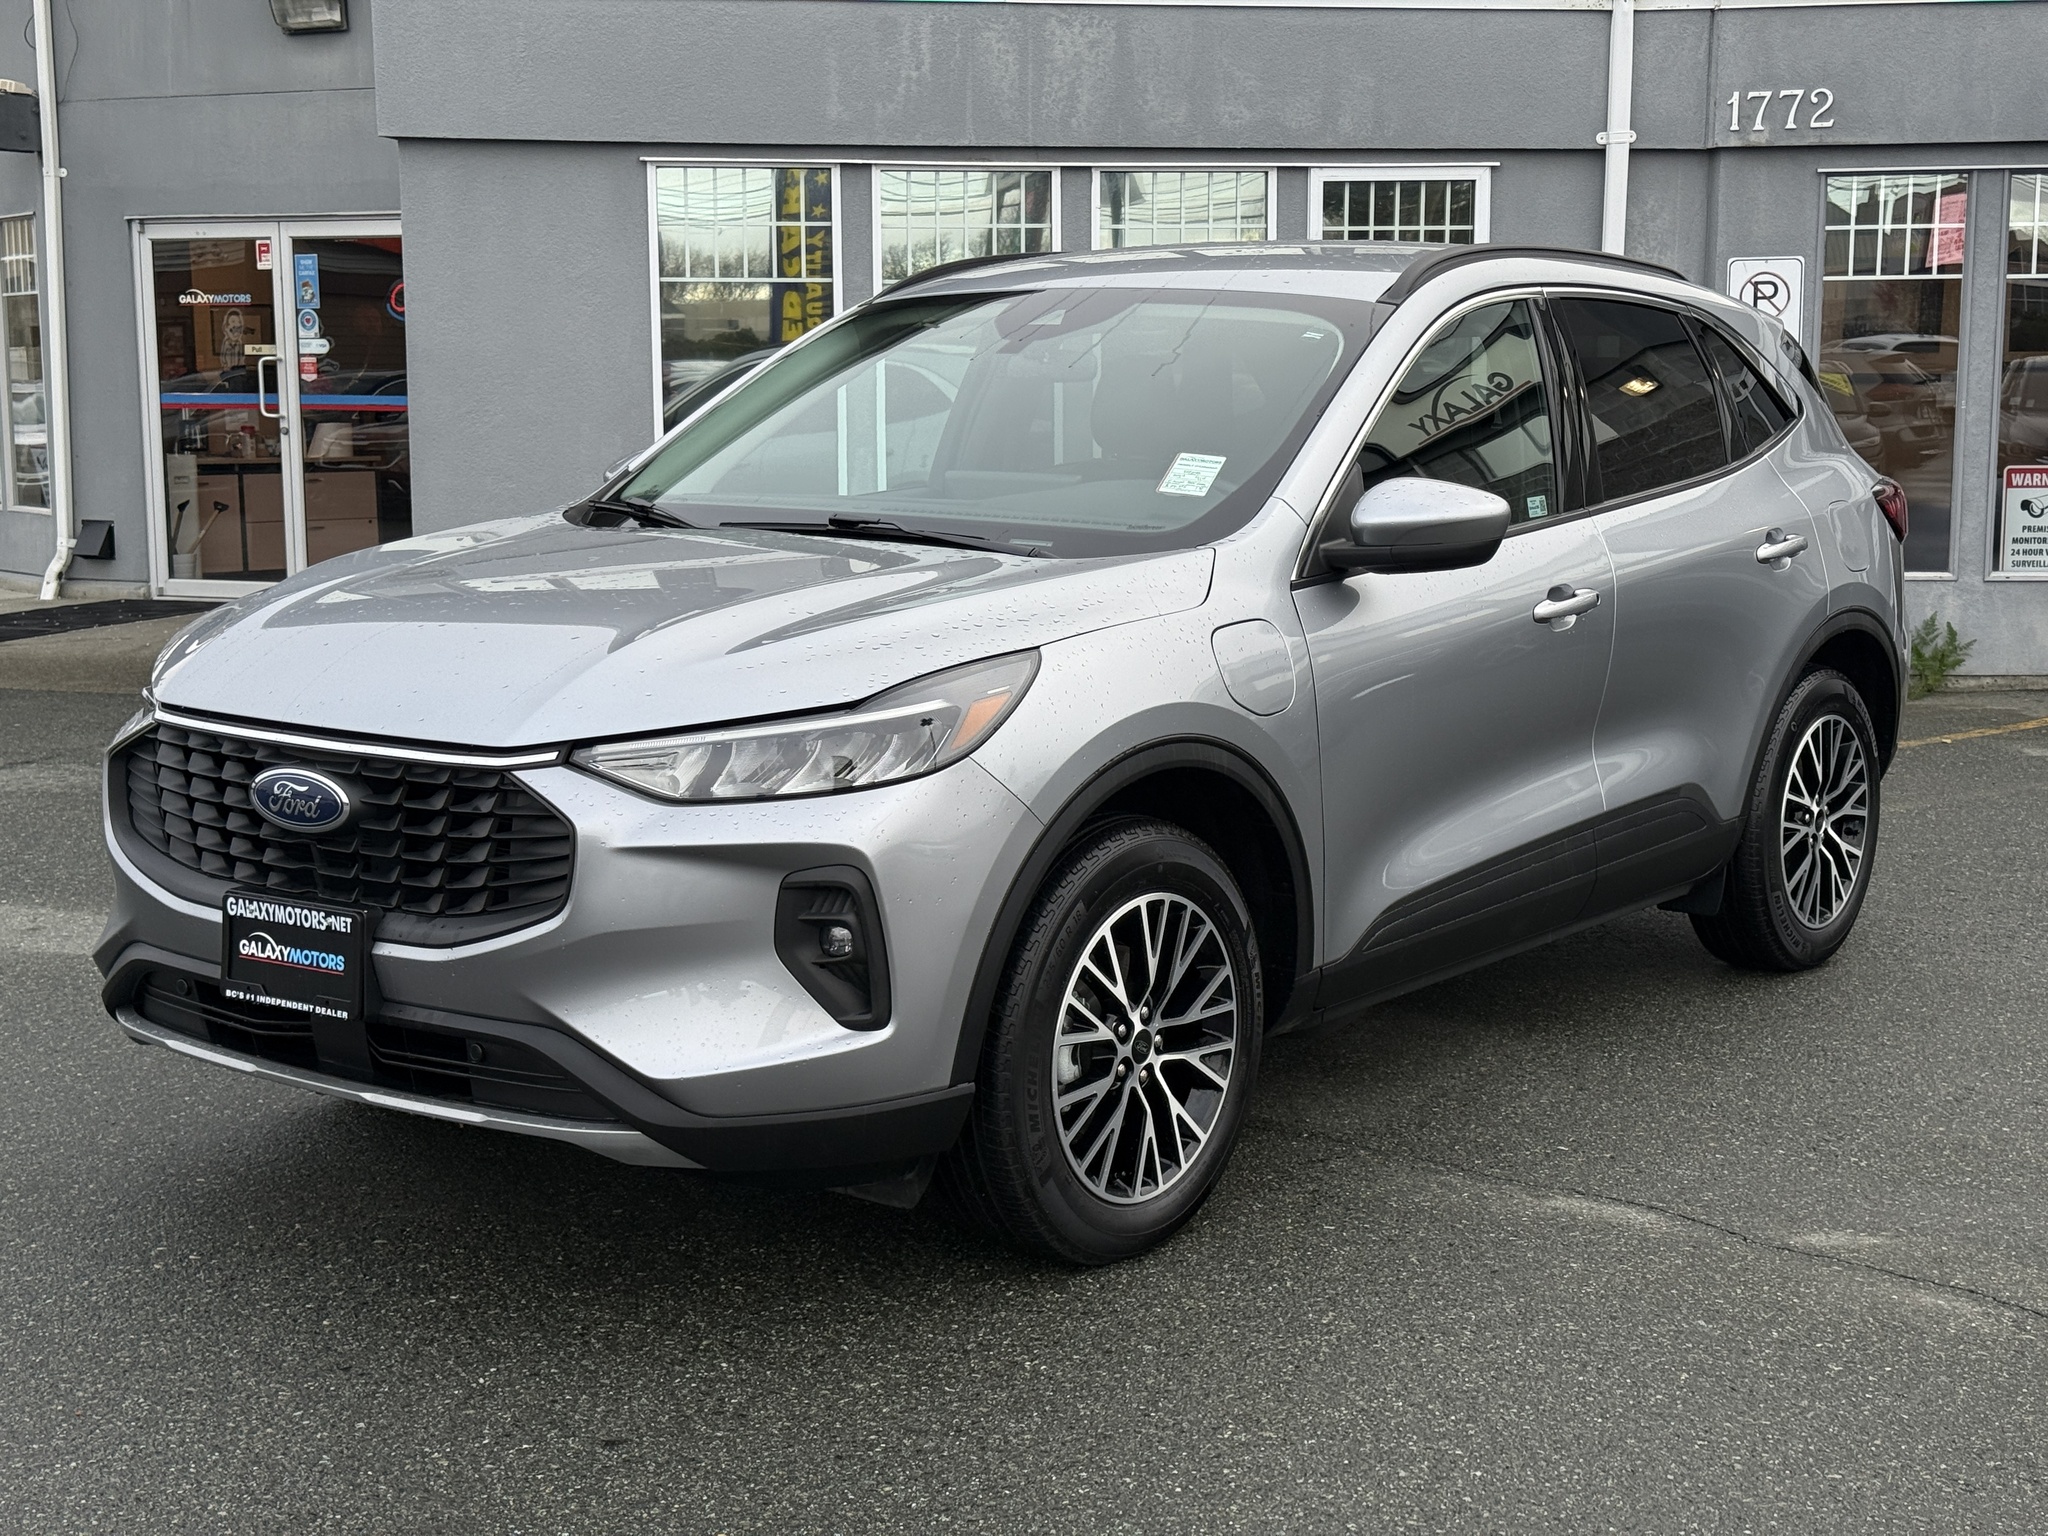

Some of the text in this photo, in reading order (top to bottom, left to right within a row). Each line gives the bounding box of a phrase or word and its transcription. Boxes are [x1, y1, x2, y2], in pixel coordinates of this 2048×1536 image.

[1727, 88, 1835, 131] 1772
[179, 289, 251, 303] GALAXYMOTORS
[2022, 525, 2048, 533] PREMI
[2011, 548, 2044, 556] 24 HOUR
[2011, 560, 2048, 568] SURVEILL
[268, 780, 322, 819] Ford
[226, 897, 352, 933] GALAXYMOTORSNET
[1065, 925, 1074, 937] R
[1072, 909, 1082, 926] 18
[1774, 895, 1801, 948] MICHELIN
[239, 932, 345, 971] GALAXYMOTORS
[225, 989, 348, 1020] BC'S #1 INDEPENDENT DEALER
